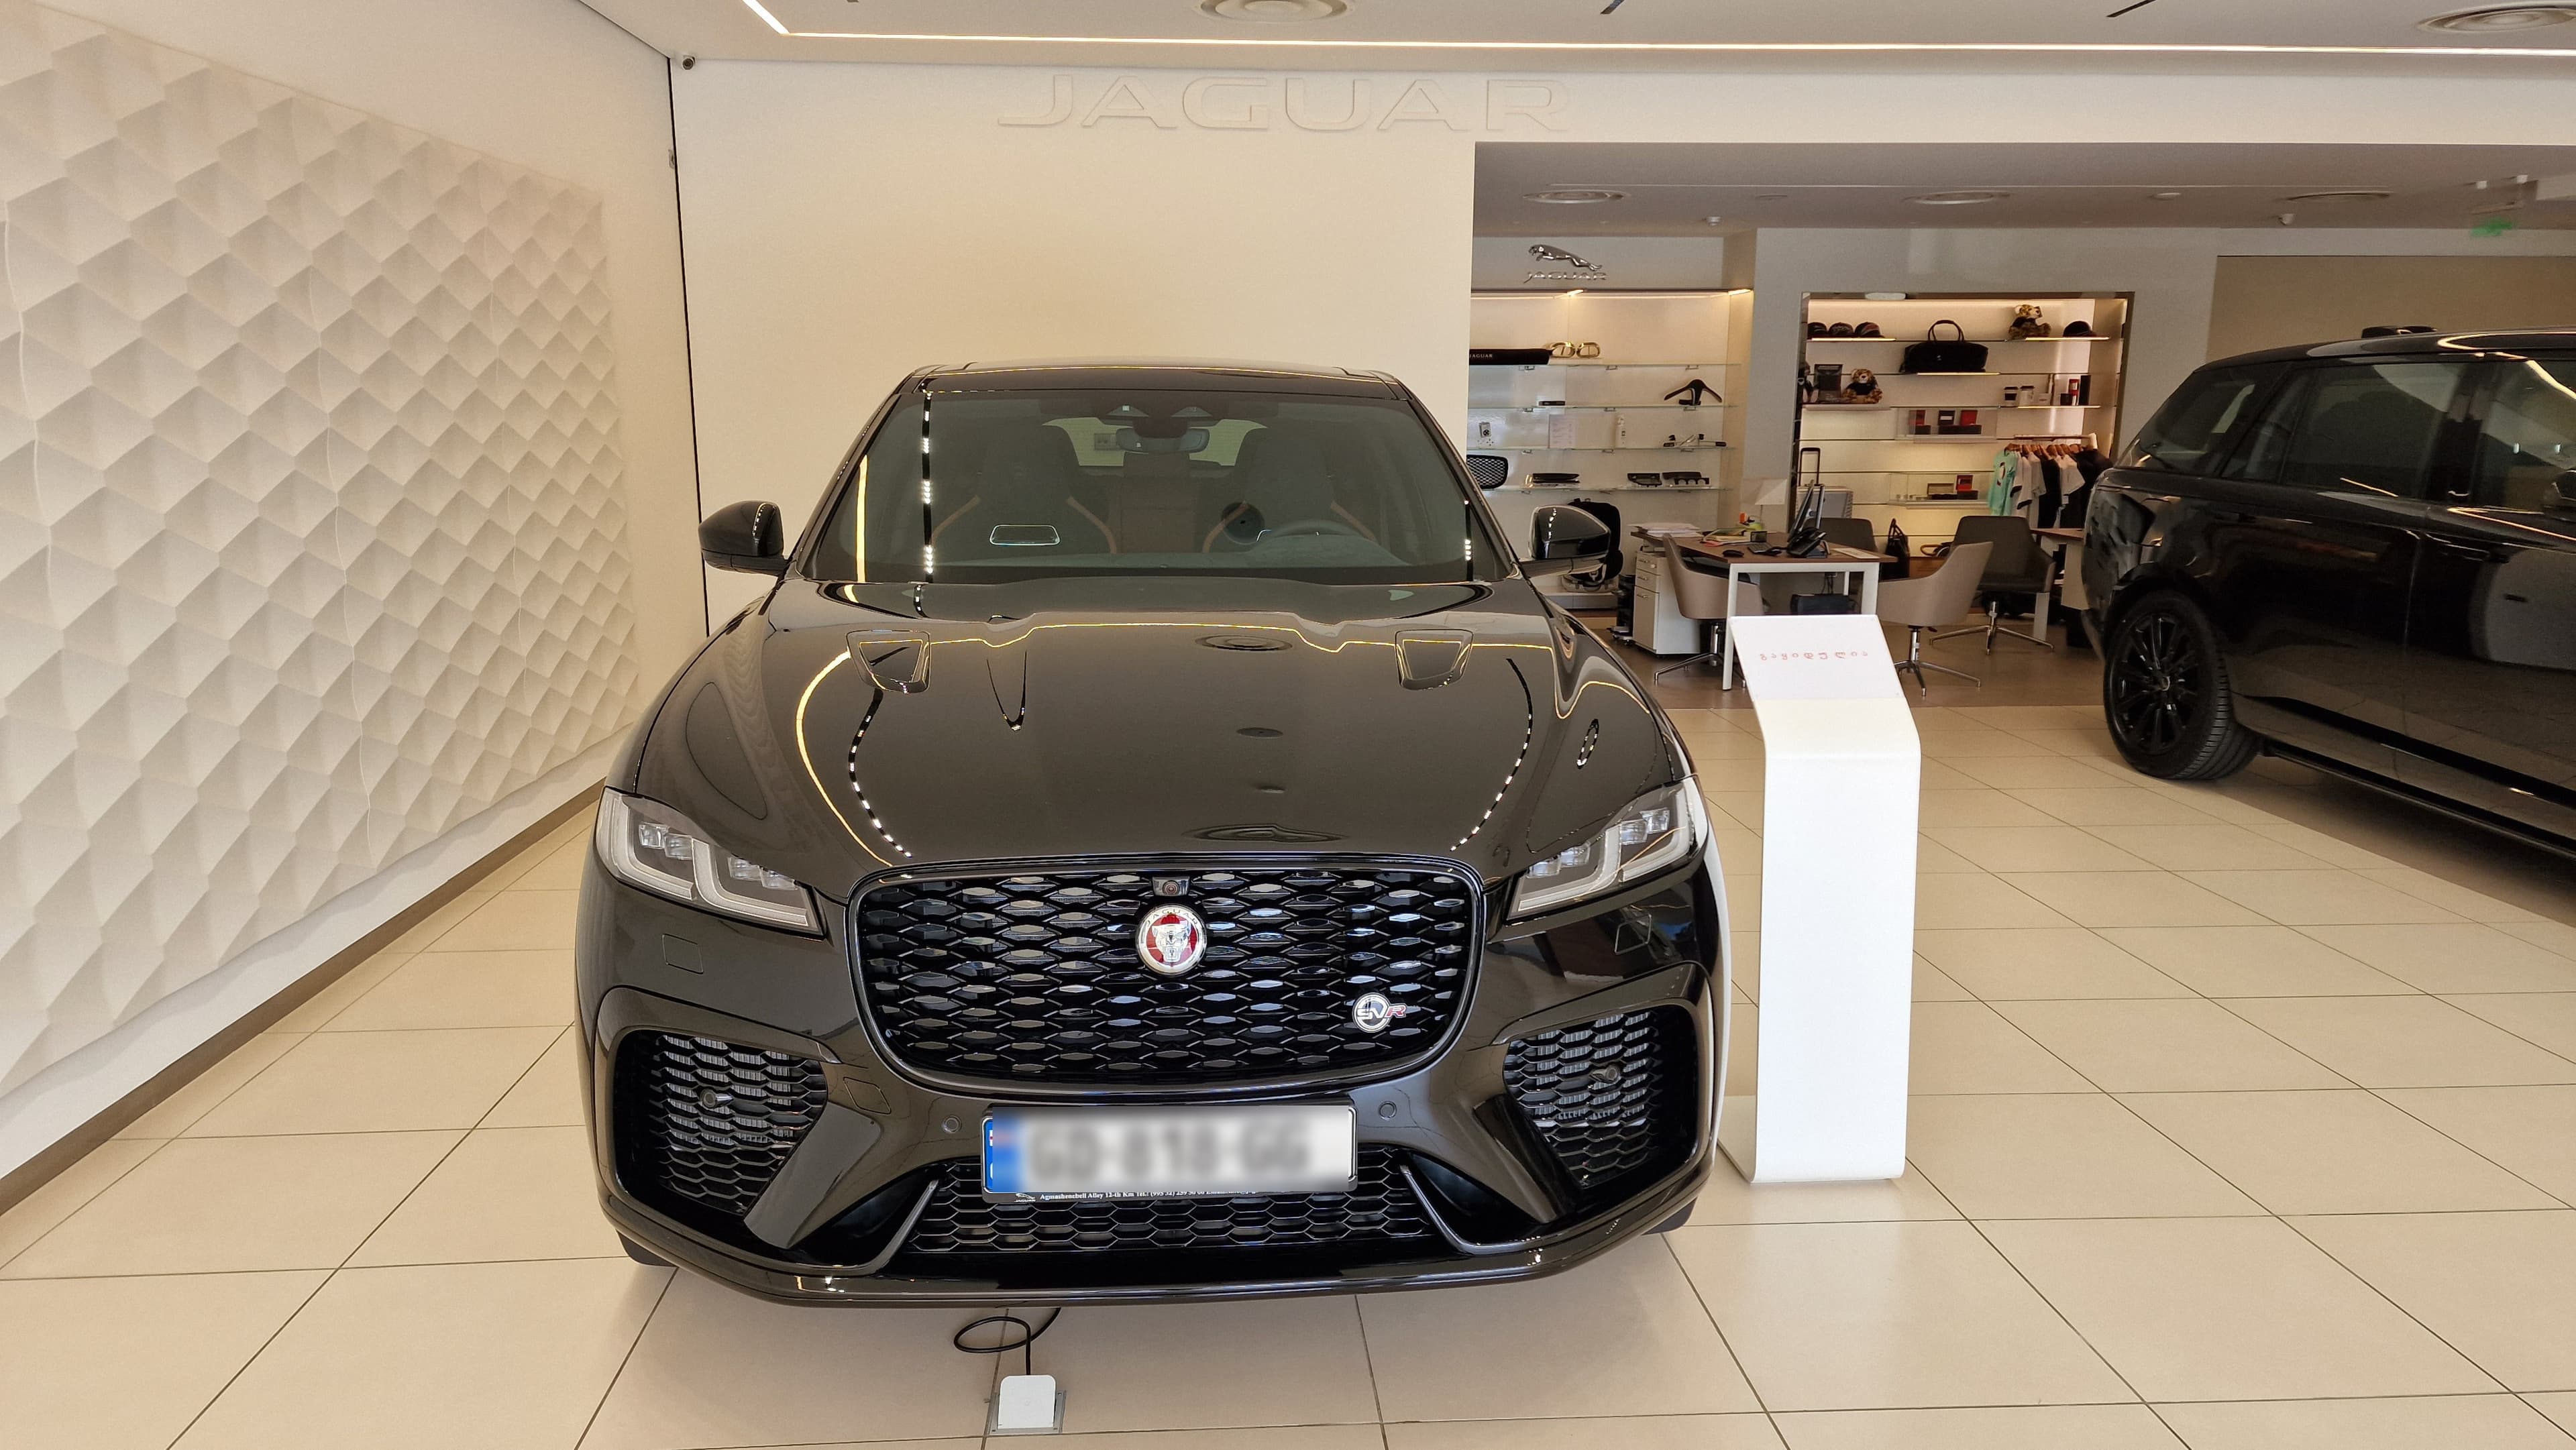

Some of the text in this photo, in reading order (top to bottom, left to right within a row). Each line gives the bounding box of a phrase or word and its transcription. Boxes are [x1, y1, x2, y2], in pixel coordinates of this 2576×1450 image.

[998, 74, 1570, 132] JAGUAR
[1523, 271, 1607, 284] JAGUAR
[1146, 908, 1199, 926] JAGUAR
[1356, 1003, 1407, 1020] SVR
